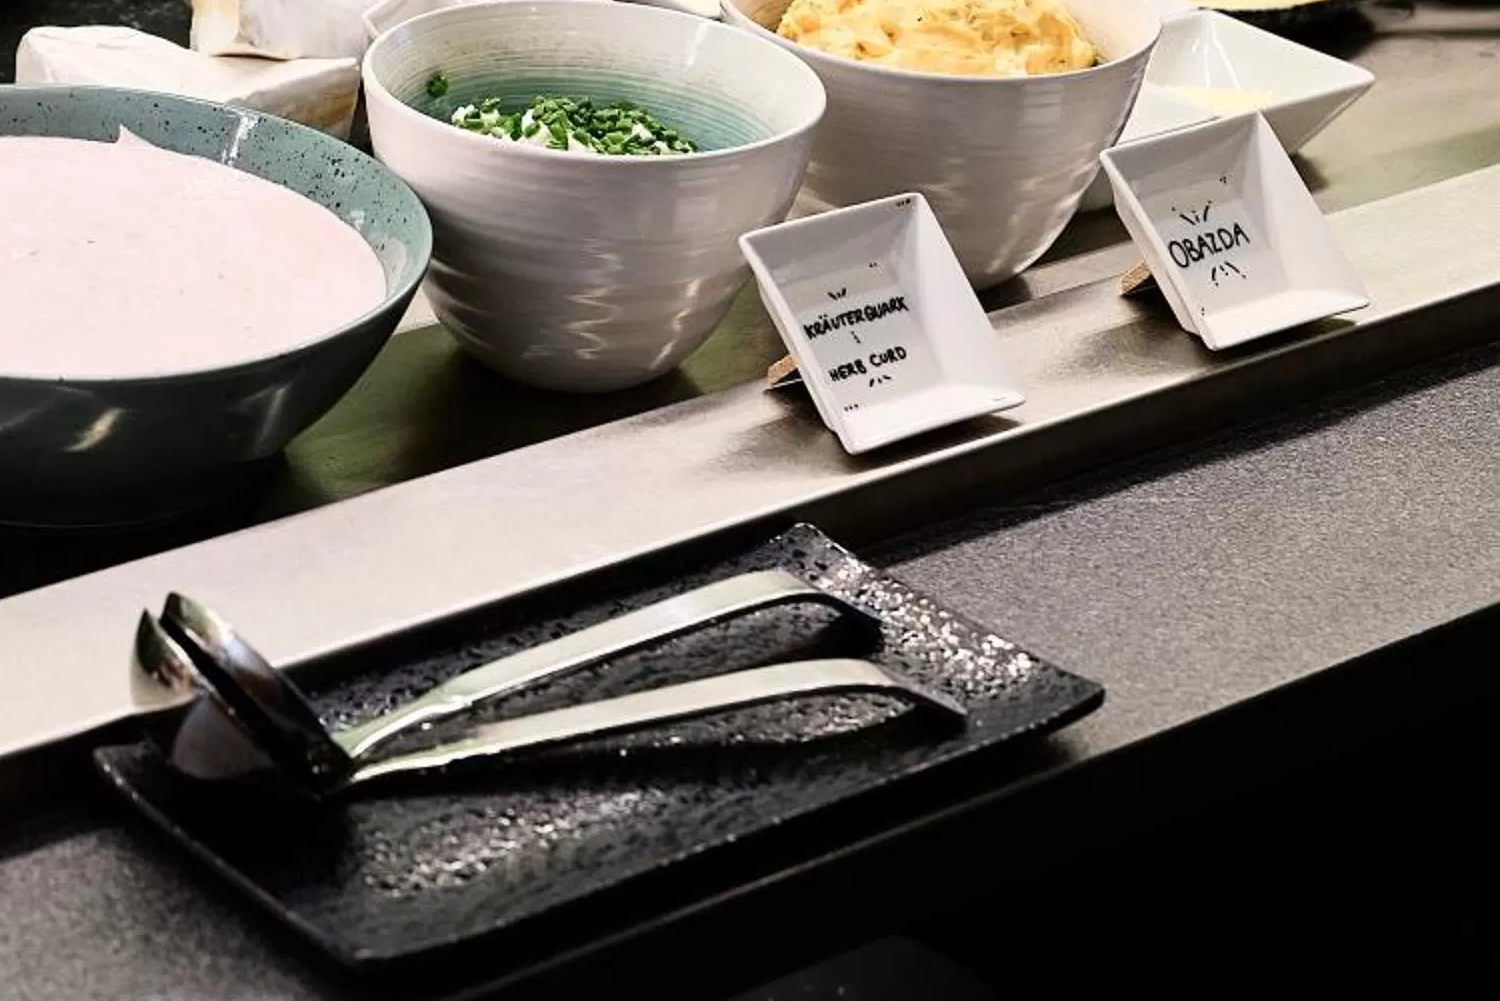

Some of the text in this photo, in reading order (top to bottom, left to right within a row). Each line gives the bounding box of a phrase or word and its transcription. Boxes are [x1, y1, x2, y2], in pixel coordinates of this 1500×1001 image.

[1168, 222, 1250, 269] OBAZDA
[803, 296, 909, 340] KRÄUTERQUARK
[828, 346, 907, 382] HERB CURD
